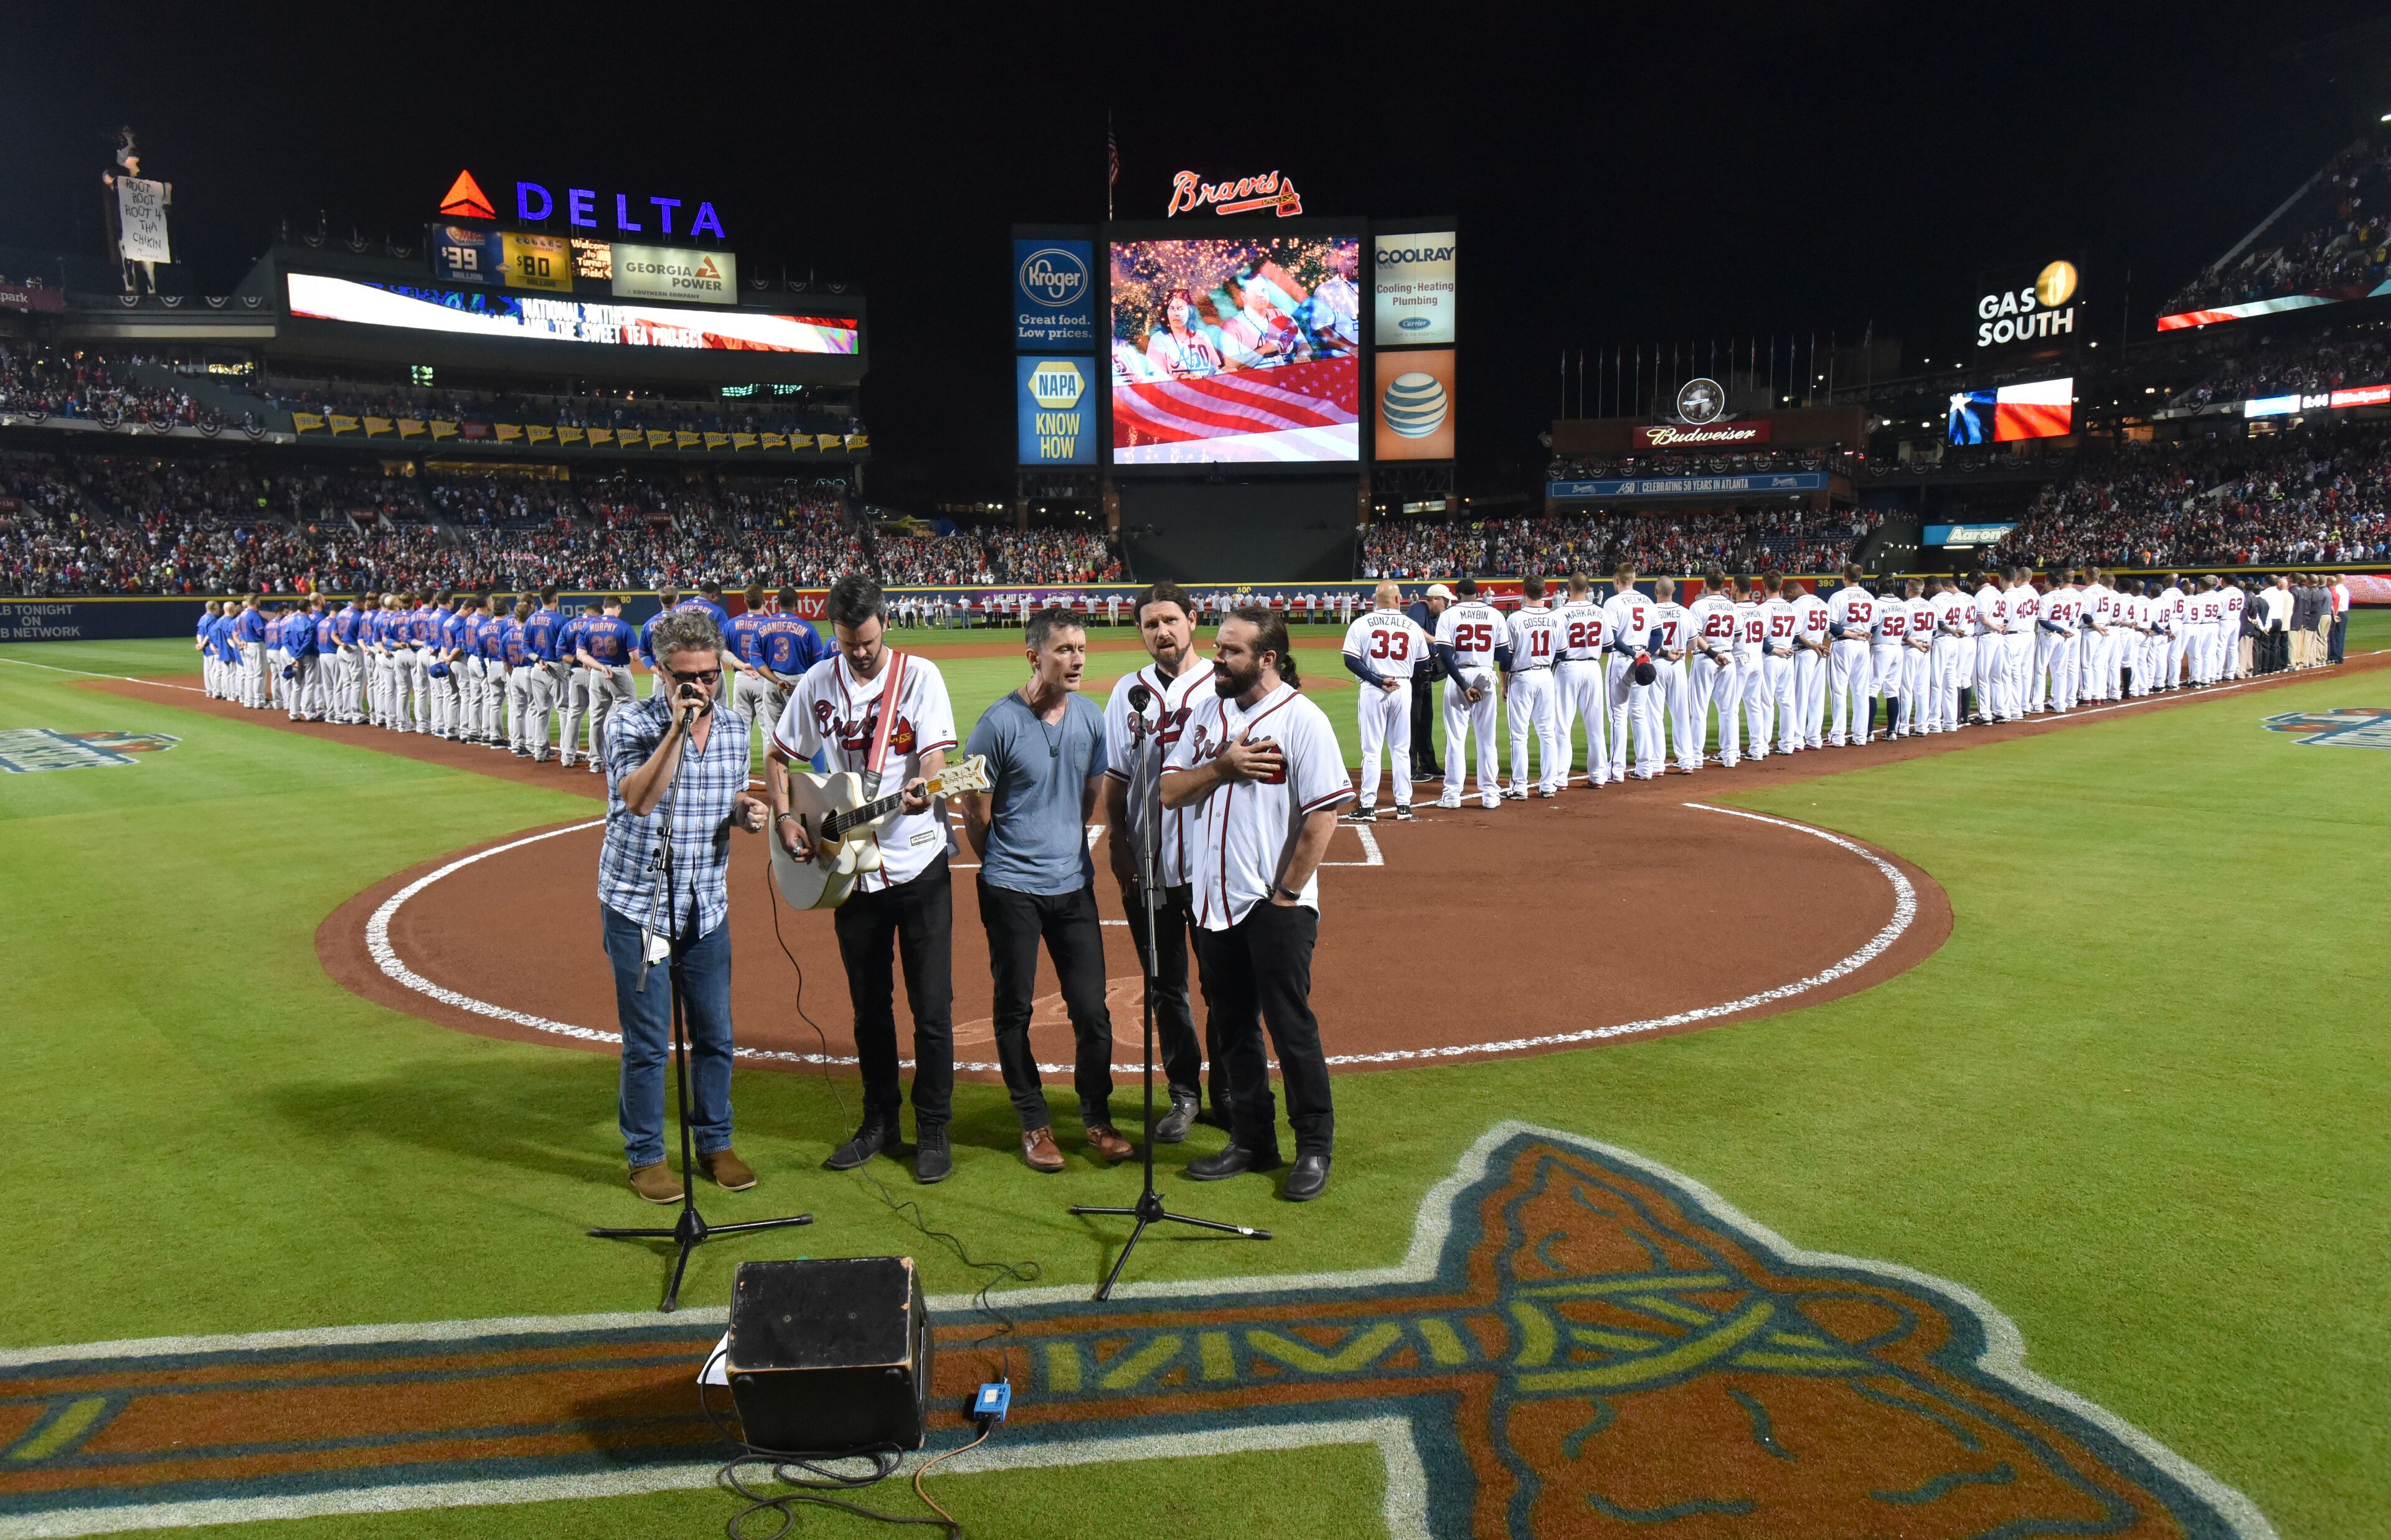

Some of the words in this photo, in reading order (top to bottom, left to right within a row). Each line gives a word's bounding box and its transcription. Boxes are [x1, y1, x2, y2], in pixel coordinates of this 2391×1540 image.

[126, 179, 150, 192] ROOT
[133, 193, 155, 205] ROOT
[1168, 171, 1278, 217] Braves
[125, 205, 151, 220] ROOT
[155, 209, 161, 221] 4
[517, 181, 725, 238] DELTA
[139, 220, 158, 233] THA
[133, 232, 162, 249] CHIKIN
[571, 239, 610, 250] Welcome
[441, 246, 478, 270] $39
[1375, 247, 1455, 265] COOLRAY
[517, 255, 550, 278] $80
[580, 268, 603, 278] Field
[626, 262, 692, 276] GEORGIA
[453, 271, 483, 281] MILLION
[527, 278, 555, 287] MILLION
[1029, 259, 1080, 298] Kroger
[672, 278, 722, 291] POWER
[1377, 284, 1412, 294] Cooling
[1417, 282, 1454, 292] Heating
[1393, 296, 1438, 306] Plumbing
[1979, 288, 2035, 319] GAS
[522, 298, 582, 322] NATIONAL
[1019, 314, 1056, 325] Great
[1059, 314, 1090, 325] food.
[1977, 308, 2073, 347] SOUTH
[581, 322, 621, 344] SWEET
[626, 325, 649, 345] TEA
[653, 327, 703, 349] PROJECT
[1018, 327, 1045, 338] Low
[1049, 327, 1092, 340] prices.
[1039, 375, 1077, 397] NAPA
[1036, 413, 1080, 435] KNOW
[847, 438, 863, 446] 2013
[1646, 427, 1756, 446] Budweiser
[1040, 436, 1075, 459] HOW
[1642, 481, 1682, 492] CELEBRATING
[1683, 481, 1692, 491] 50
[1693, 480, 1712, 491] YEARS
[1713, 480, 1720, 490] IN
[1721, 478, 1748, 490] ATLANTA
[1622, 596, 1651, 606] FREEMAN
[1847, 592, 1870, 601] JOHNSON
[2096, 596, 2109, 613] 15
[2228, 598, 2242, 611] 62
[14, 604, 73, 615] TONIGHT
[763, 596, 824, 617] xfity
[1565, 608, 1603, 621] MARKAKIS
[1658, 609, 1681, 618] GOMES
[1708, 602, 1734, 612] JOHNSON
[1742, 610, 1763, 619] SIMMONS
[1773, 605, 1793, 613] MARTIN
[1847, 603, 1872, 622] 53
[1993, 599, 2006, 618] 39
[2026, 598, 2040, 616] 34
[2050, 604, 2071, 620] 24
[2127, 604, 2134, 619] 4
[2191, 607, 2199, 621] 9
[2205, 604, 2219, 617] 59
[22, 616, 41, 626] ON
[531, 616, 551, 627] FLORES
[1460, 610, 1489, 620] MAYBIN
[1523, 617, 1557, 629] GOSSELIN
[1633, 607, 1644, 631] 5
[1808, 610, 1828, 631] 56
[1913, 612, 1935, 631] 50
[1945, 607, 1960, 626] 49
[2159, 609, 2171, 623] 18
[14, 626, 80, 637] NETWORK
[568, 621, 587, 632] LAGA
[590, 622, 618, 633] MURPHY
[758, 621, 808, 637] GRANDERSON
[1367, 616, 1412, 631] GONZALEZ
[1705, 614, 1735, 637] 23
[1771, 615, 1795, 637] 57
[1882, 616, 1905, 636] 52
[536, 629, 546, 649] 4
[1455, 624, 1493, 652] 25
[1569, 621, 1602, 647] 22
[1662, 621, 1677, 646] 7
[1745, 621, 1763, 644] 19
[487, 636, 499, 657] 6
[592, 636, 618, 657] 28
[774, 637, 790, 662] 3
[1370, 629, 1410, 661] 33
[1531, 630, 1550, 657] 11
